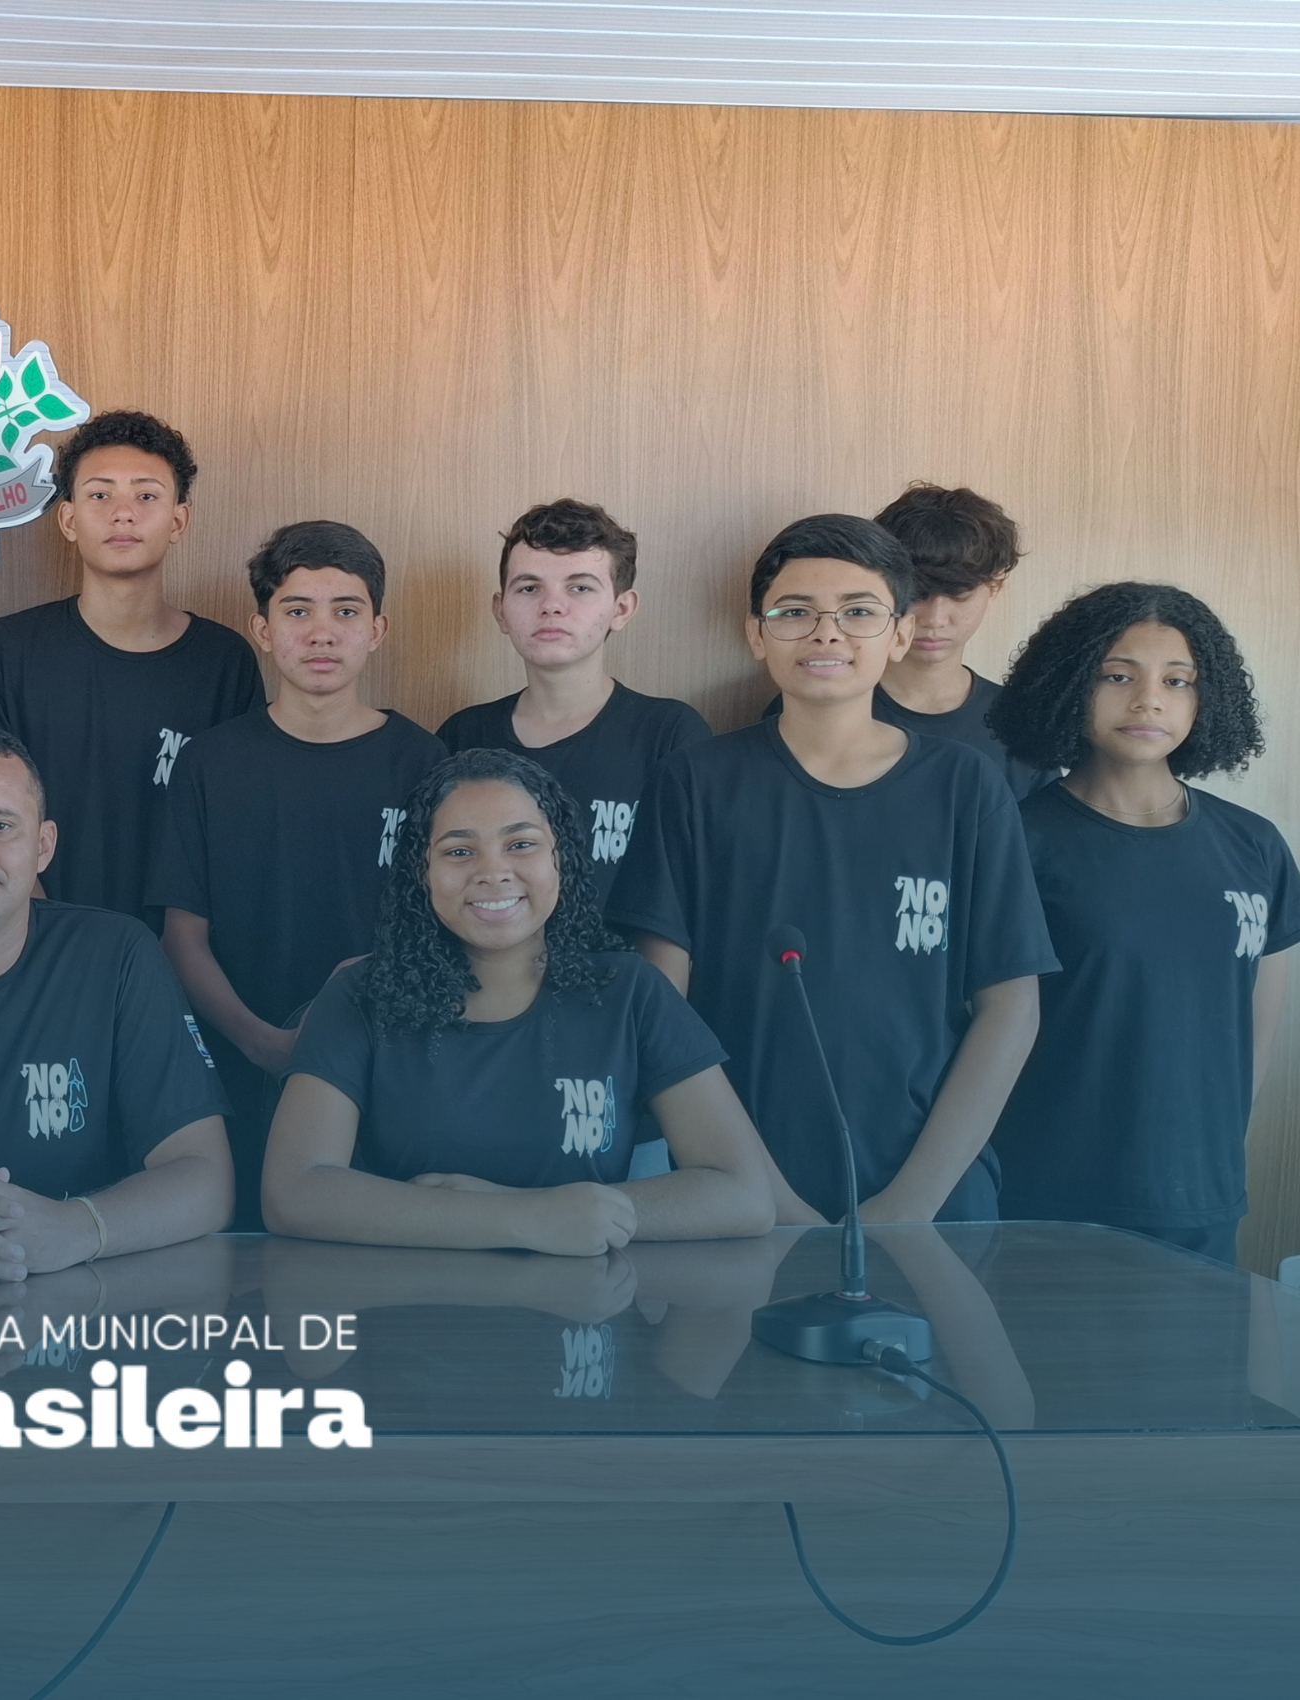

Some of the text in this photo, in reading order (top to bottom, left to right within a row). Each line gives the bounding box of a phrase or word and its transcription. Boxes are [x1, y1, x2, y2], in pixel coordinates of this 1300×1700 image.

[590, 799, 631, 834] NO
[592, 830, 627, 865] NO
[894, 876, 947, 917] NO
[1224, 890, 1268, 927] NO
[895, 913, 943, 955] NO
[1234, 921, 1266, 962] NO
[20, 1063, 68, 1105] NO
[554, 1078, 605, 1119] NO
[28, 1099, 70, 1140] NO
[561, 1113, 604, 1158] NO
